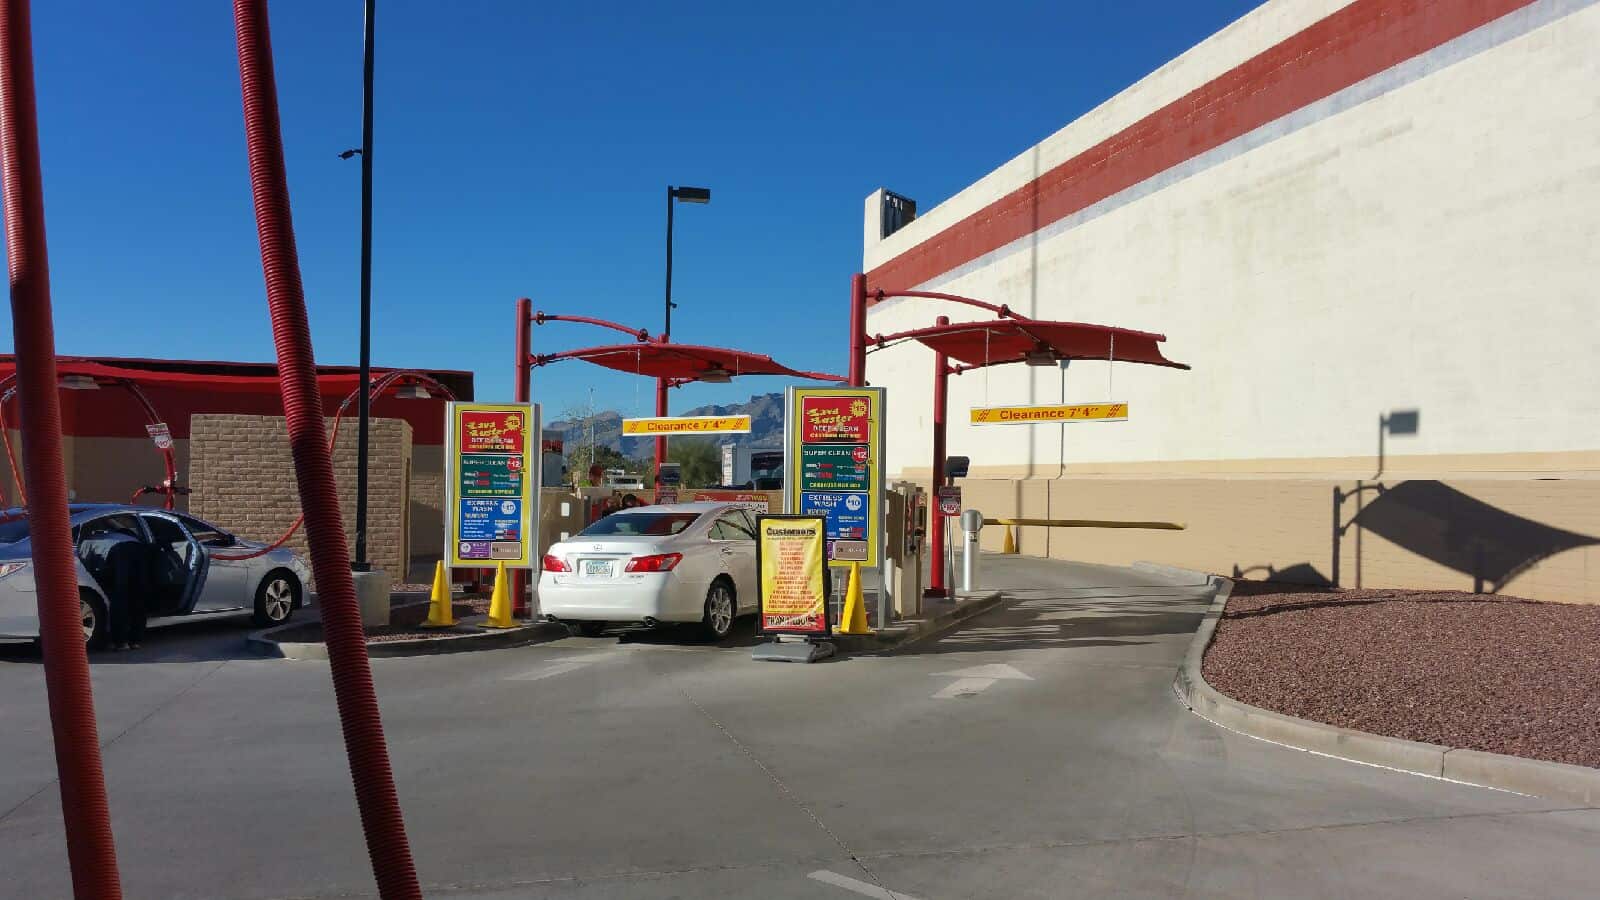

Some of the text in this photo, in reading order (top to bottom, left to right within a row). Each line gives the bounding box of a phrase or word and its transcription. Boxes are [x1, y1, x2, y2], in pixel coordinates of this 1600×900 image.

[999, 408, 1065, 420] Clearance
[647, 421, 700, 431] Clearance
[766, 527, 817, 536] Customers
